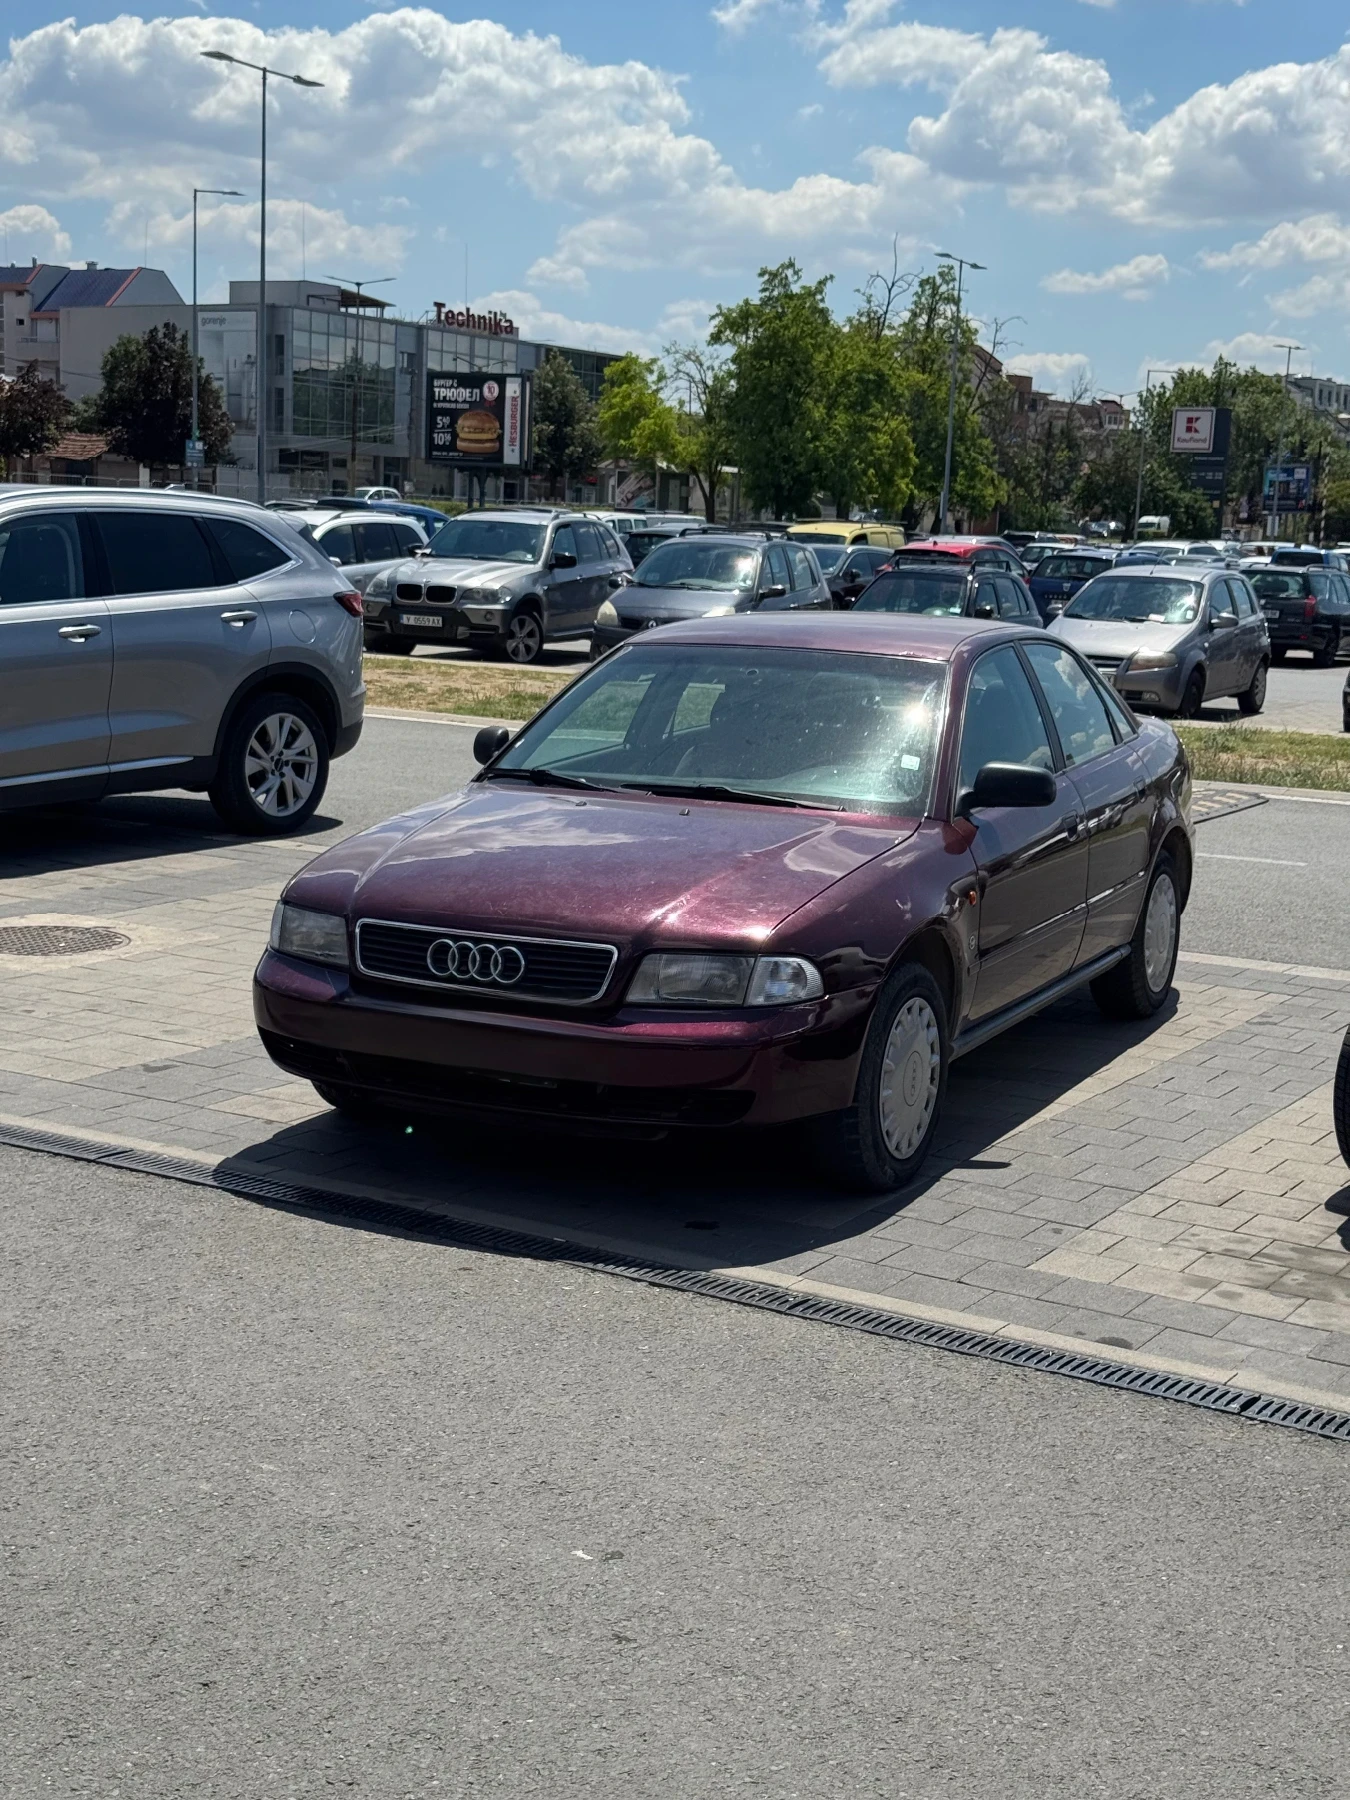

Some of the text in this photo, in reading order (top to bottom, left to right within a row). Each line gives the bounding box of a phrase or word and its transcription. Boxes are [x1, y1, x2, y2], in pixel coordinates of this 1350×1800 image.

[433, 301, 514, 335] Technika
[433, 387, 480, 402] ТРЮФЕЛ
[509, 395, 519, 447] HESBURGER
[1177, 436, 1208, 444] Kaufland
